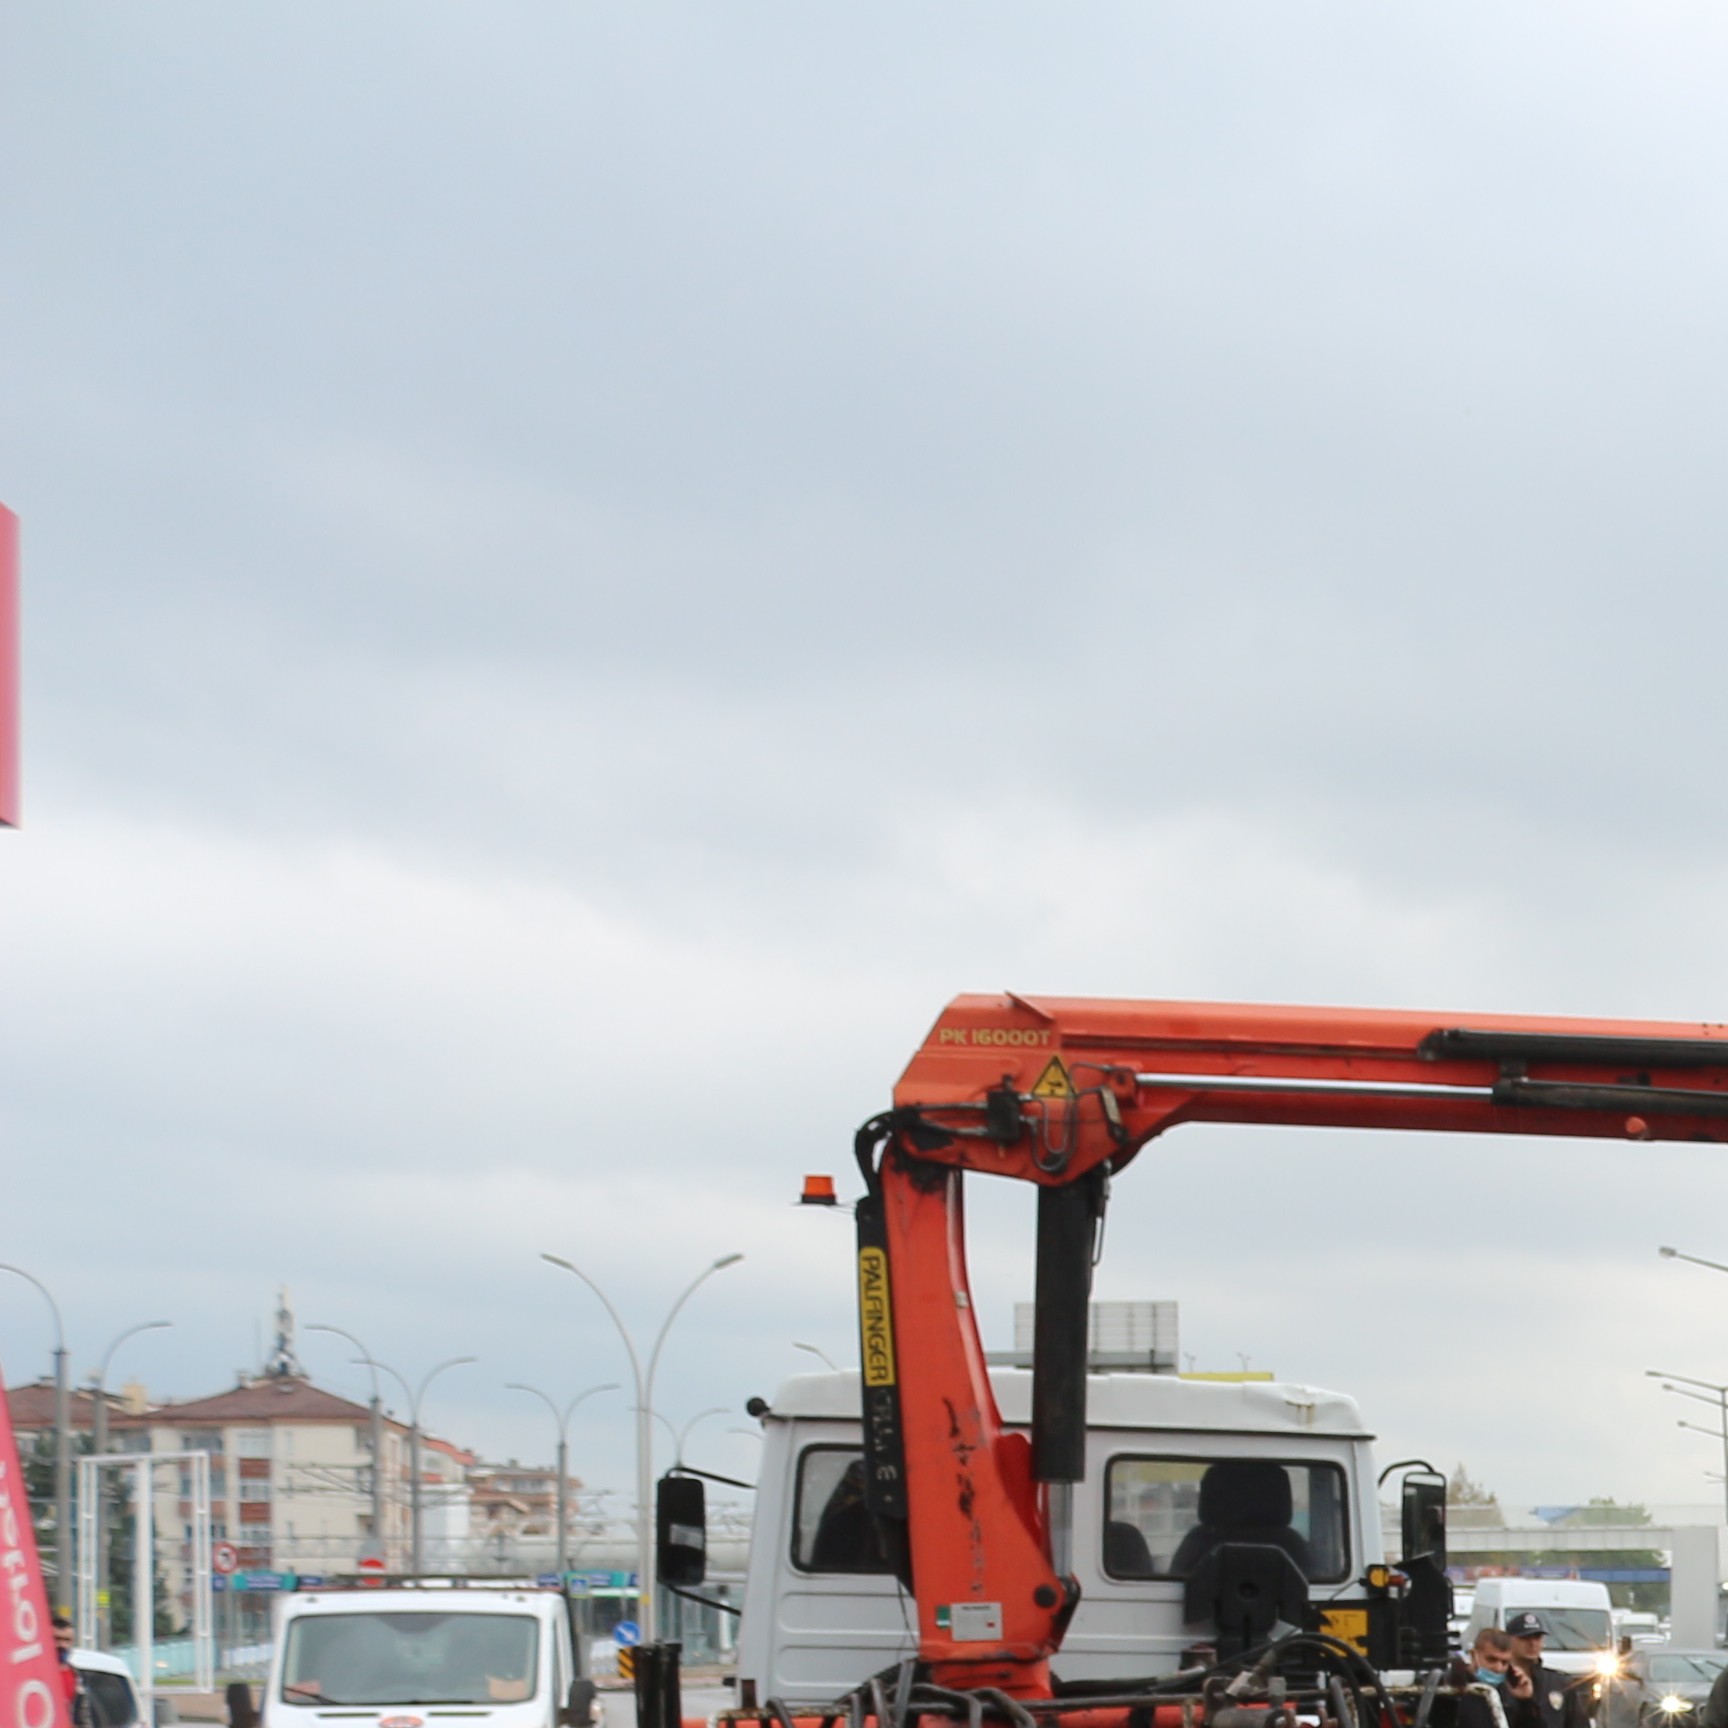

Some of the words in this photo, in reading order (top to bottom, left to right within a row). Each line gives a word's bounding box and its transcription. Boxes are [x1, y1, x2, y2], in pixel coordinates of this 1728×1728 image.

[940, 1028, 967, 1045] PK
[971, 1027, 1051, 1046] 16000T
[862, 1255, 889, 1382] PALFINGER
